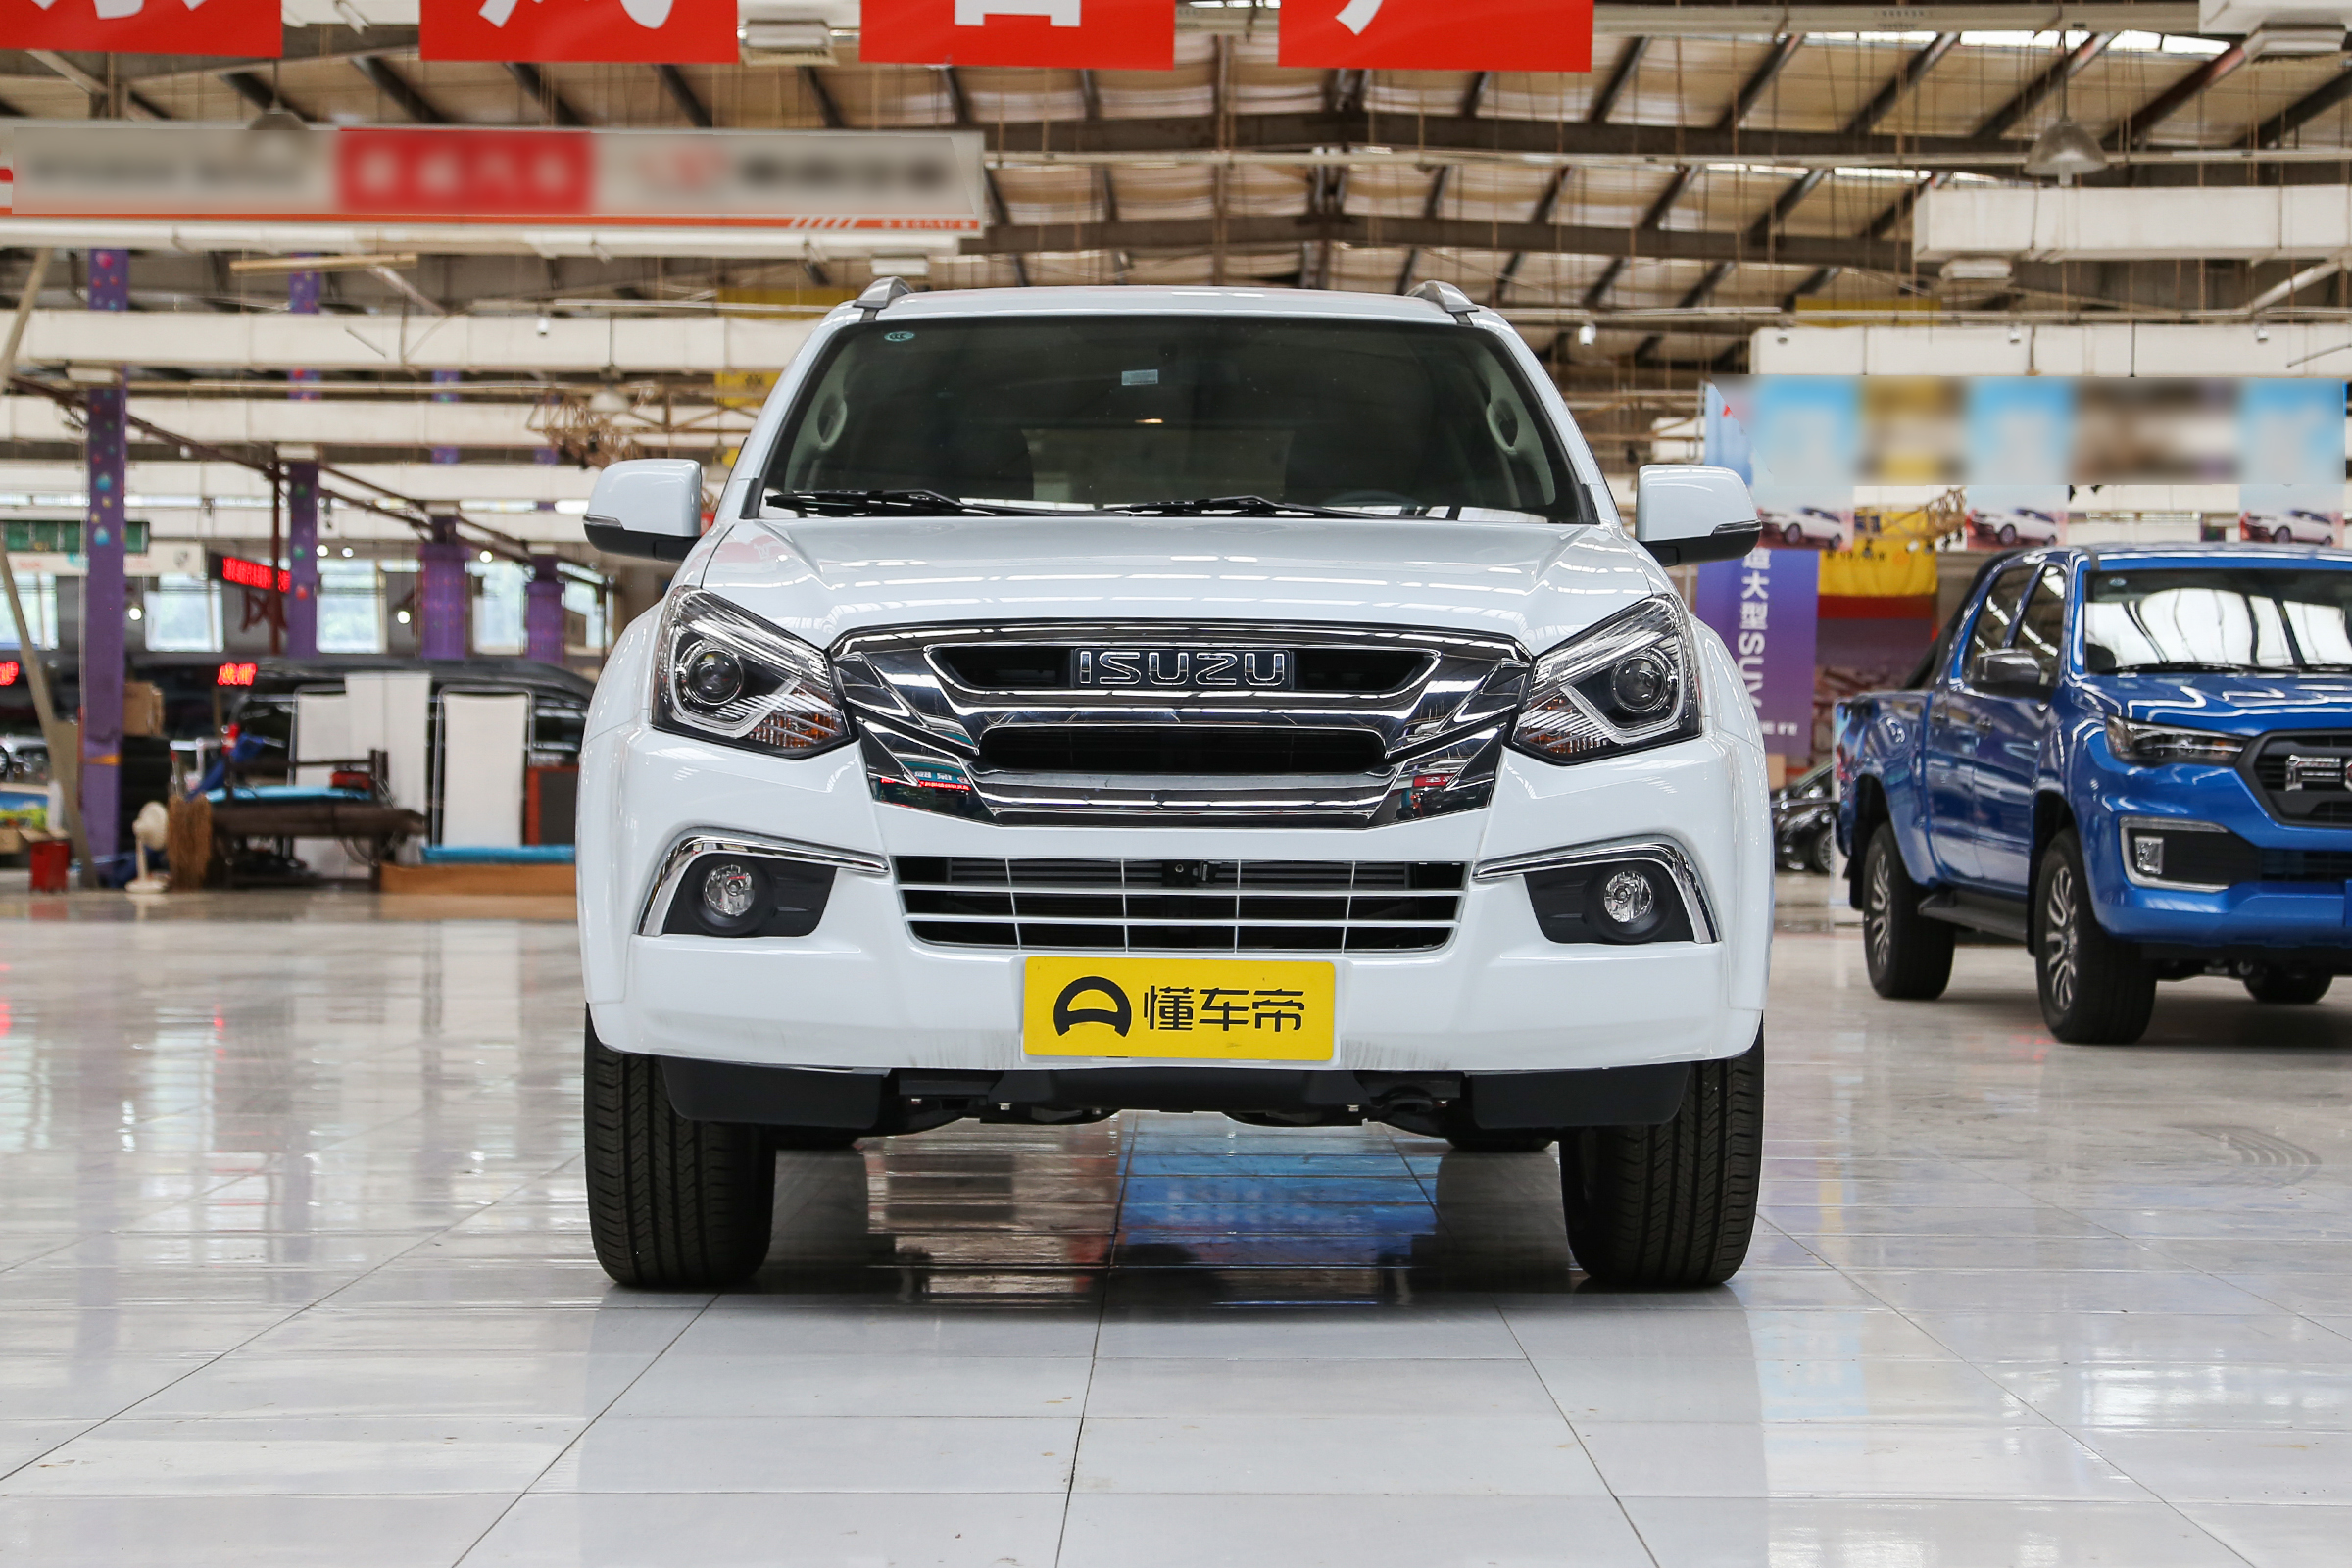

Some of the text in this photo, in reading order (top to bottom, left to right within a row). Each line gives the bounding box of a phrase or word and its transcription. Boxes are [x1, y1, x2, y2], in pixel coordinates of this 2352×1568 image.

[1080, 651, 1285, 686] ISUZU
[1143, 985, 1305, 1033] 懂车帝
